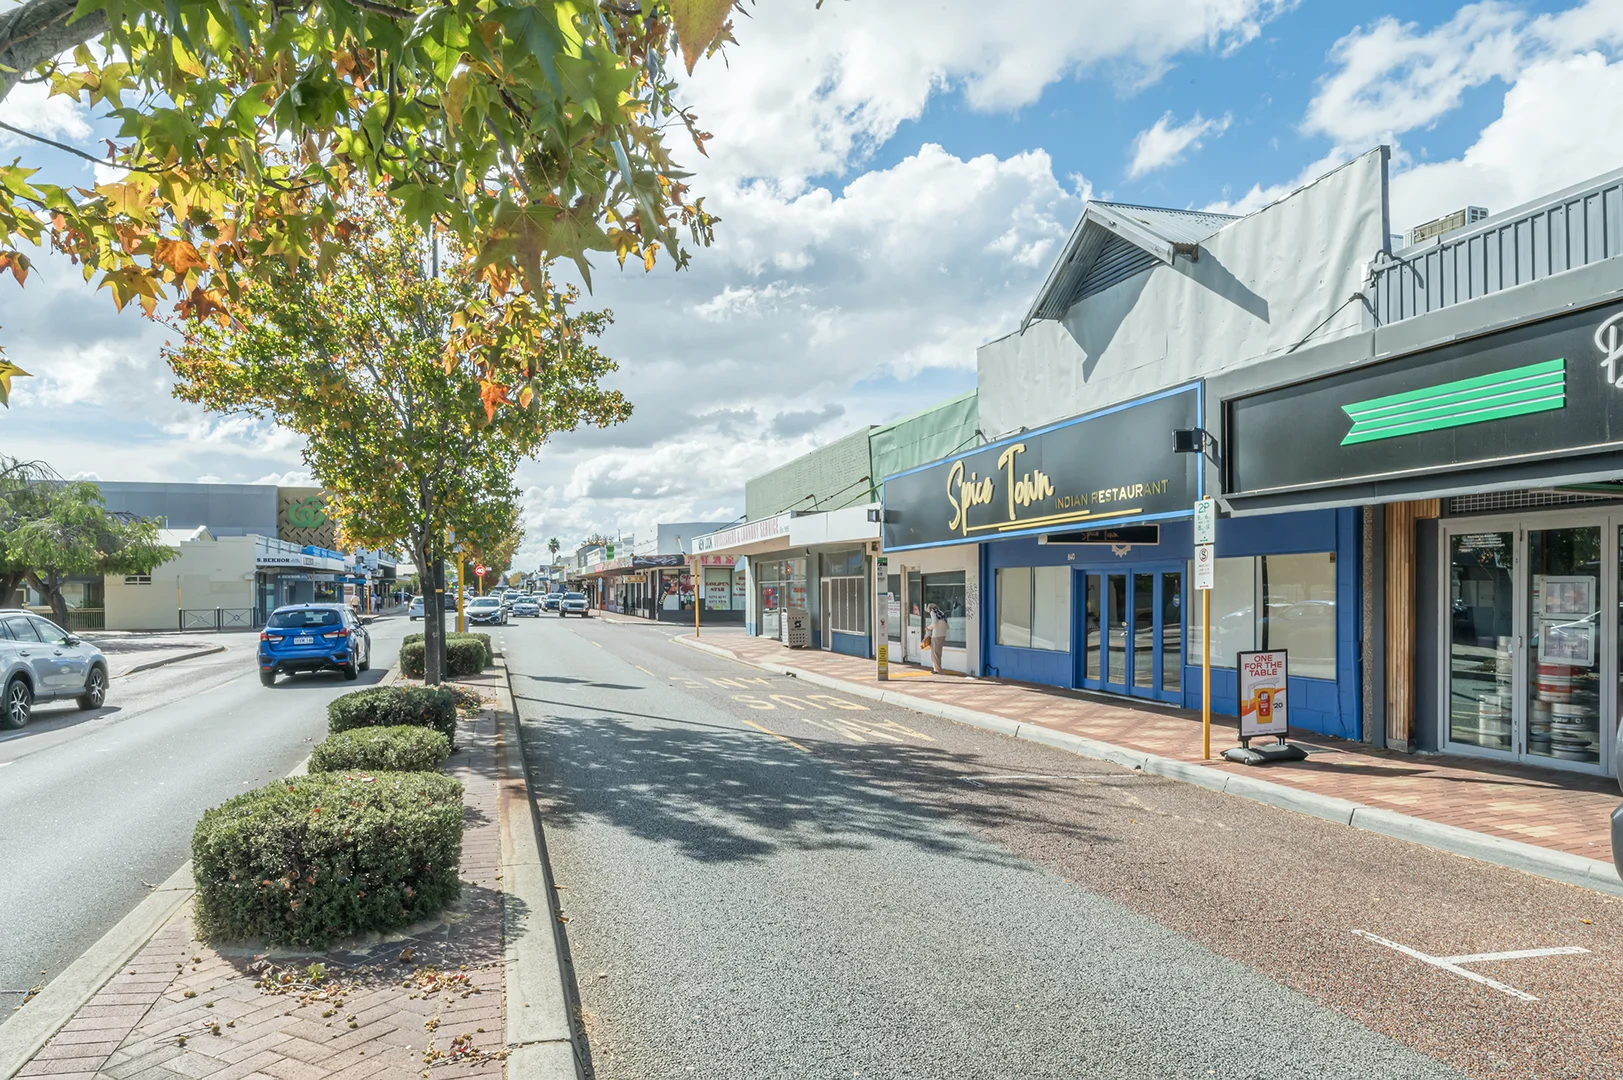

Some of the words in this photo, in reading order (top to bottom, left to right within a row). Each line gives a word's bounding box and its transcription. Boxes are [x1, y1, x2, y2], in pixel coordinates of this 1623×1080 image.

[947, 460, 995, 537] Spice
[998, 443, 1055, 521] Town
[1055, 493, 1088, 510] INDIAN
[1092, 479, 1169, 504] RESTAURANT
[1198, 502, 1210, 514] 2P
[760, 518, 779, 538] SERVICE
[1244, 662, 1263, 670] FOR
[1249, 668, 1278, 677] TABLE
